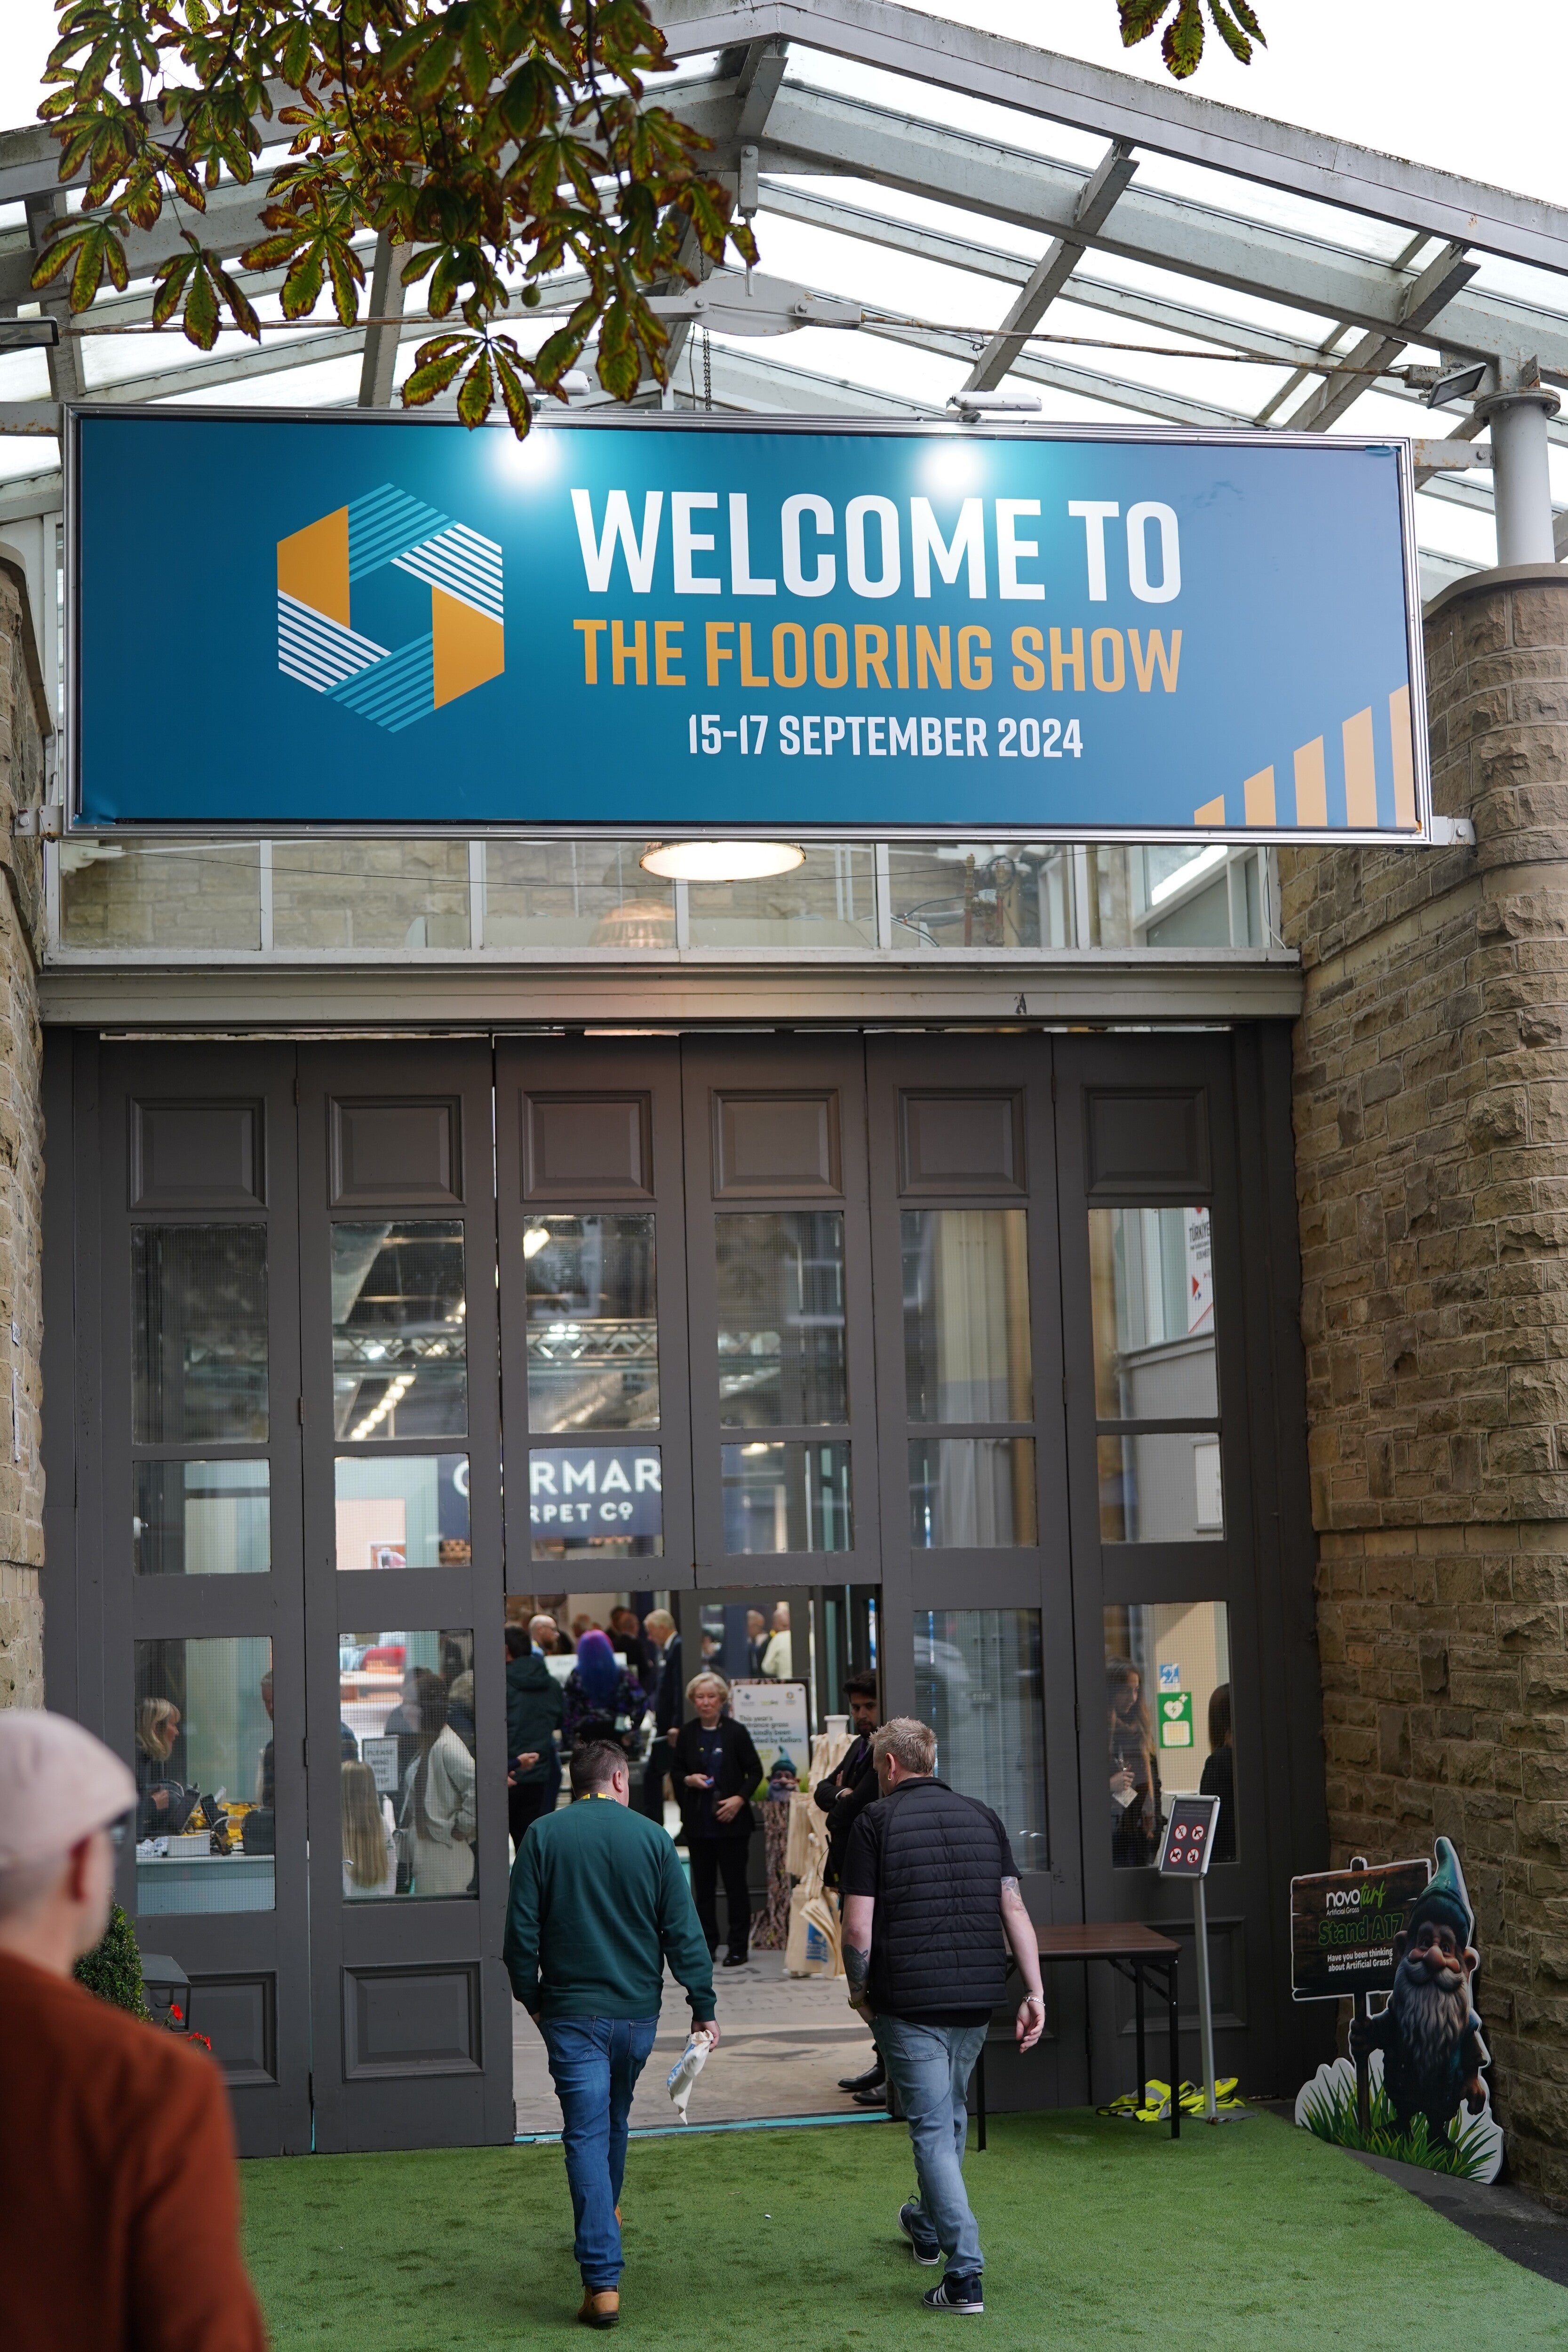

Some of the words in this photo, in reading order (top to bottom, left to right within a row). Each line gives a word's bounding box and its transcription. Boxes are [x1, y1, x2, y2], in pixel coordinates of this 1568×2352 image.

[570, 489, 1045, 600] WELCOME
[1068, 501, 1181, 604] TO
[573, 620, 686, 686] THE
[705, 622, 993, 691] FLOORING
[1011, 627, 1182, 693] SHOW
[689, 714, 768, 755] 15-17
[779, 715, 989, 757] SEPTEMBER
[997, 718, 1084, 759] 2024
[1326, 1880, 1386, 1909] novoturf
[1326, 1907, 1345, 1916] Artificial
[1318, 1915, 1369, 1946] Stand
[1371, 1913, 1404, 1941] A17
[1327, 1954, 1342, 1963] Have
[1343, 1953, 1353, 1962] you
[1354, 1950, 1368, 1959] been
[1369, 1947, 1393, 1957] thinking
[1328, 1964, 1345, 1972] about
[1346, 1959, 1372, 1971] Artificial
[1372, 1957, 1393, 1967] Grass?
